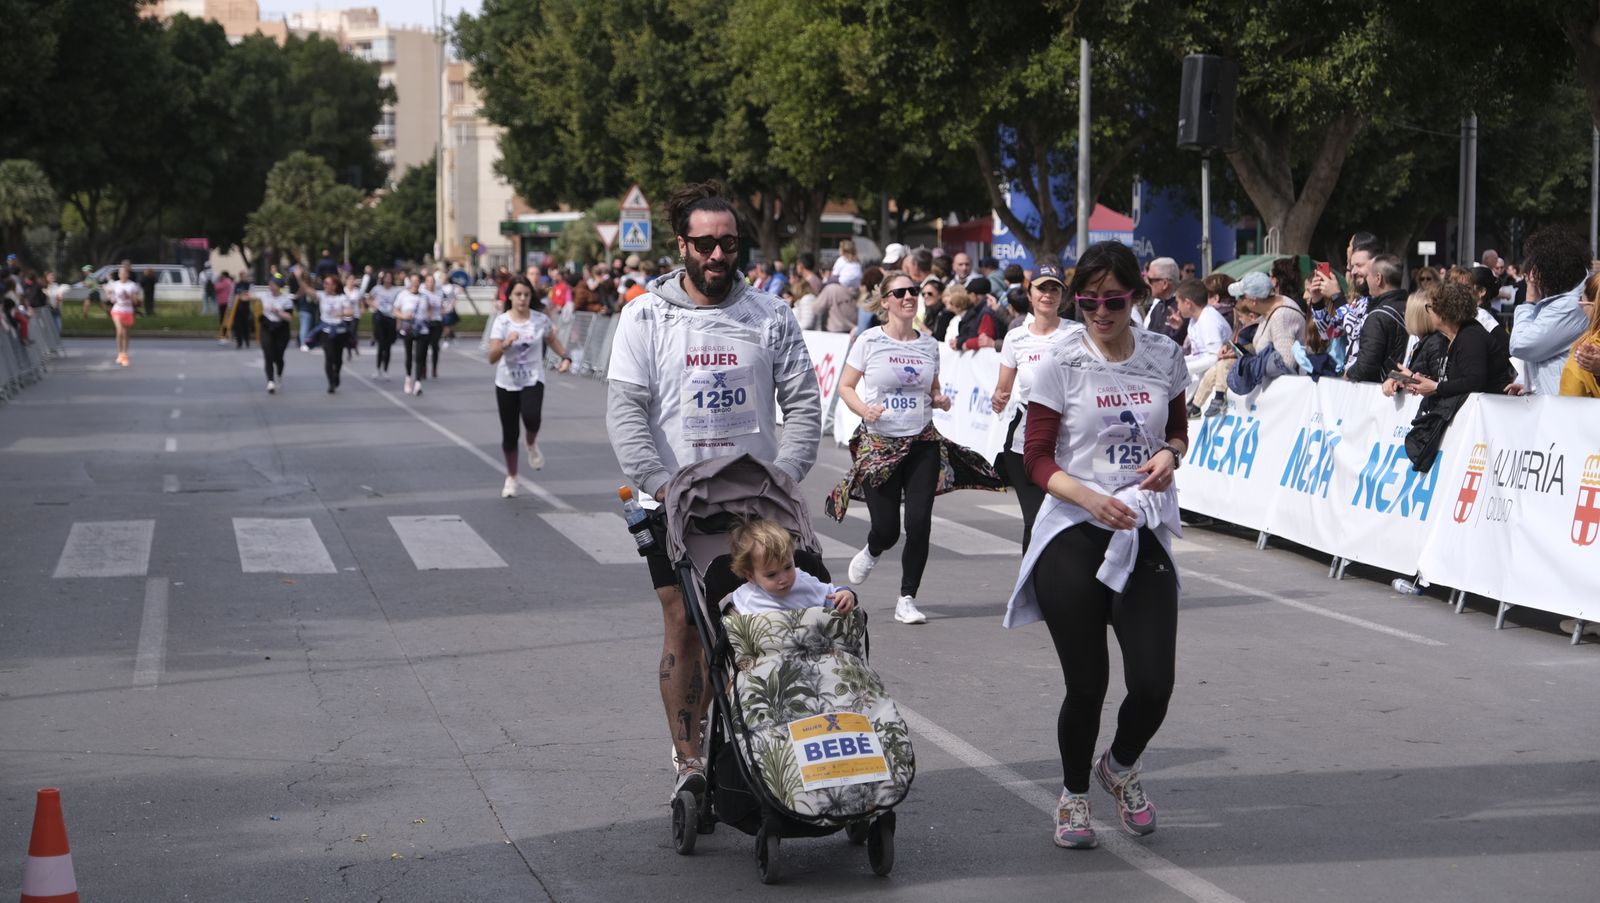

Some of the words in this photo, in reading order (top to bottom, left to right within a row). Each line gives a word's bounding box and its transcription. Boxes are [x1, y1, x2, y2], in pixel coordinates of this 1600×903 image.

[686, 353, 738, 366] MUJER
[889, 356, 923, 365] MUJER
[692, 387, 747, 409] 1250
[883, 397, 917, 409] 1085
[1189, 415, 1260, 479] NEXA
[1280, 427, 1341, 498] NEXA
[1492, 442, 1564, 496] ALMERÍA
[804, 733, 874, 761] BEBÉ
